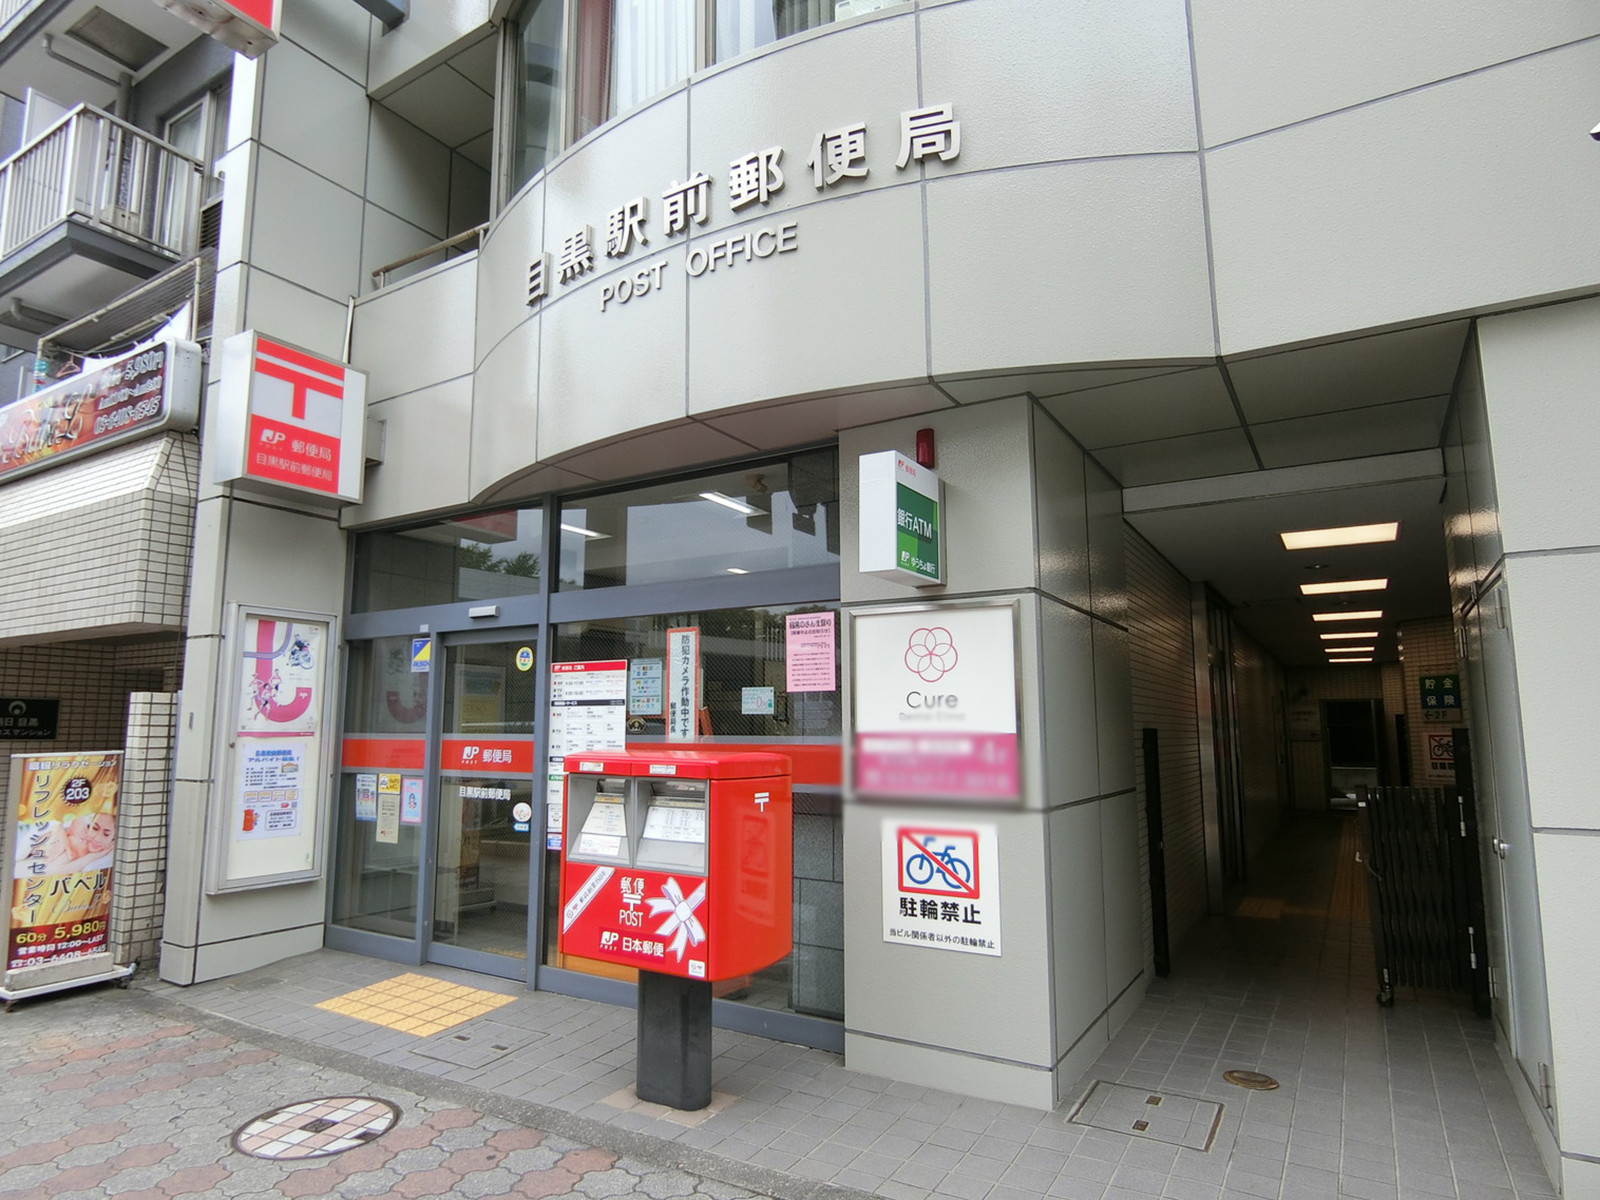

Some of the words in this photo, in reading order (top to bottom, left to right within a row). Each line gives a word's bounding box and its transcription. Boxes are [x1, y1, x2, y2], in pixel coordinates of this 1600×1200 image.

[526, 102, 963, 307] 目黒駅前郵便局
[600, 260, 668, 312] POST
[685, 221, 799, 277] OFFICE
[261, 429, 286, 444] JP
[291, 439, 332, 462] 郵便局
[256, 453, 333, 481] 目黒駅前郵便局
[897, 508, 932, 540] 銀行ATM
[911, 556, 936, 574] ゆうちょ銀行
[681, 634, 690, 738] 防犯カメラ作動中です
[906, 691, 959, 709] Cure
[462, 746, 479, 759] JP
[482, 749, 512, 764] 郵便局
[71, 778, 86, 787] 2F
[66, 787, 90, 801] 203
[459, 786, 512, 801] 目黒駅前郵便局
[25, 774, 50, 923] リフレッシュセンター
[50, 873, 107, 896] バベル
[620, 877, 645, 897] 郵便
[619, 909, 644, 928] POST
[899, 896, 982, 925] 駐輪禁止
[16, 933, 47, 944] 60分
[601, 931, 619, 946] JP
[622, 937, 664, 958] 日本郵便
[889, 928, 996, 949] 当ビル関係者以外の駐輪禁止
